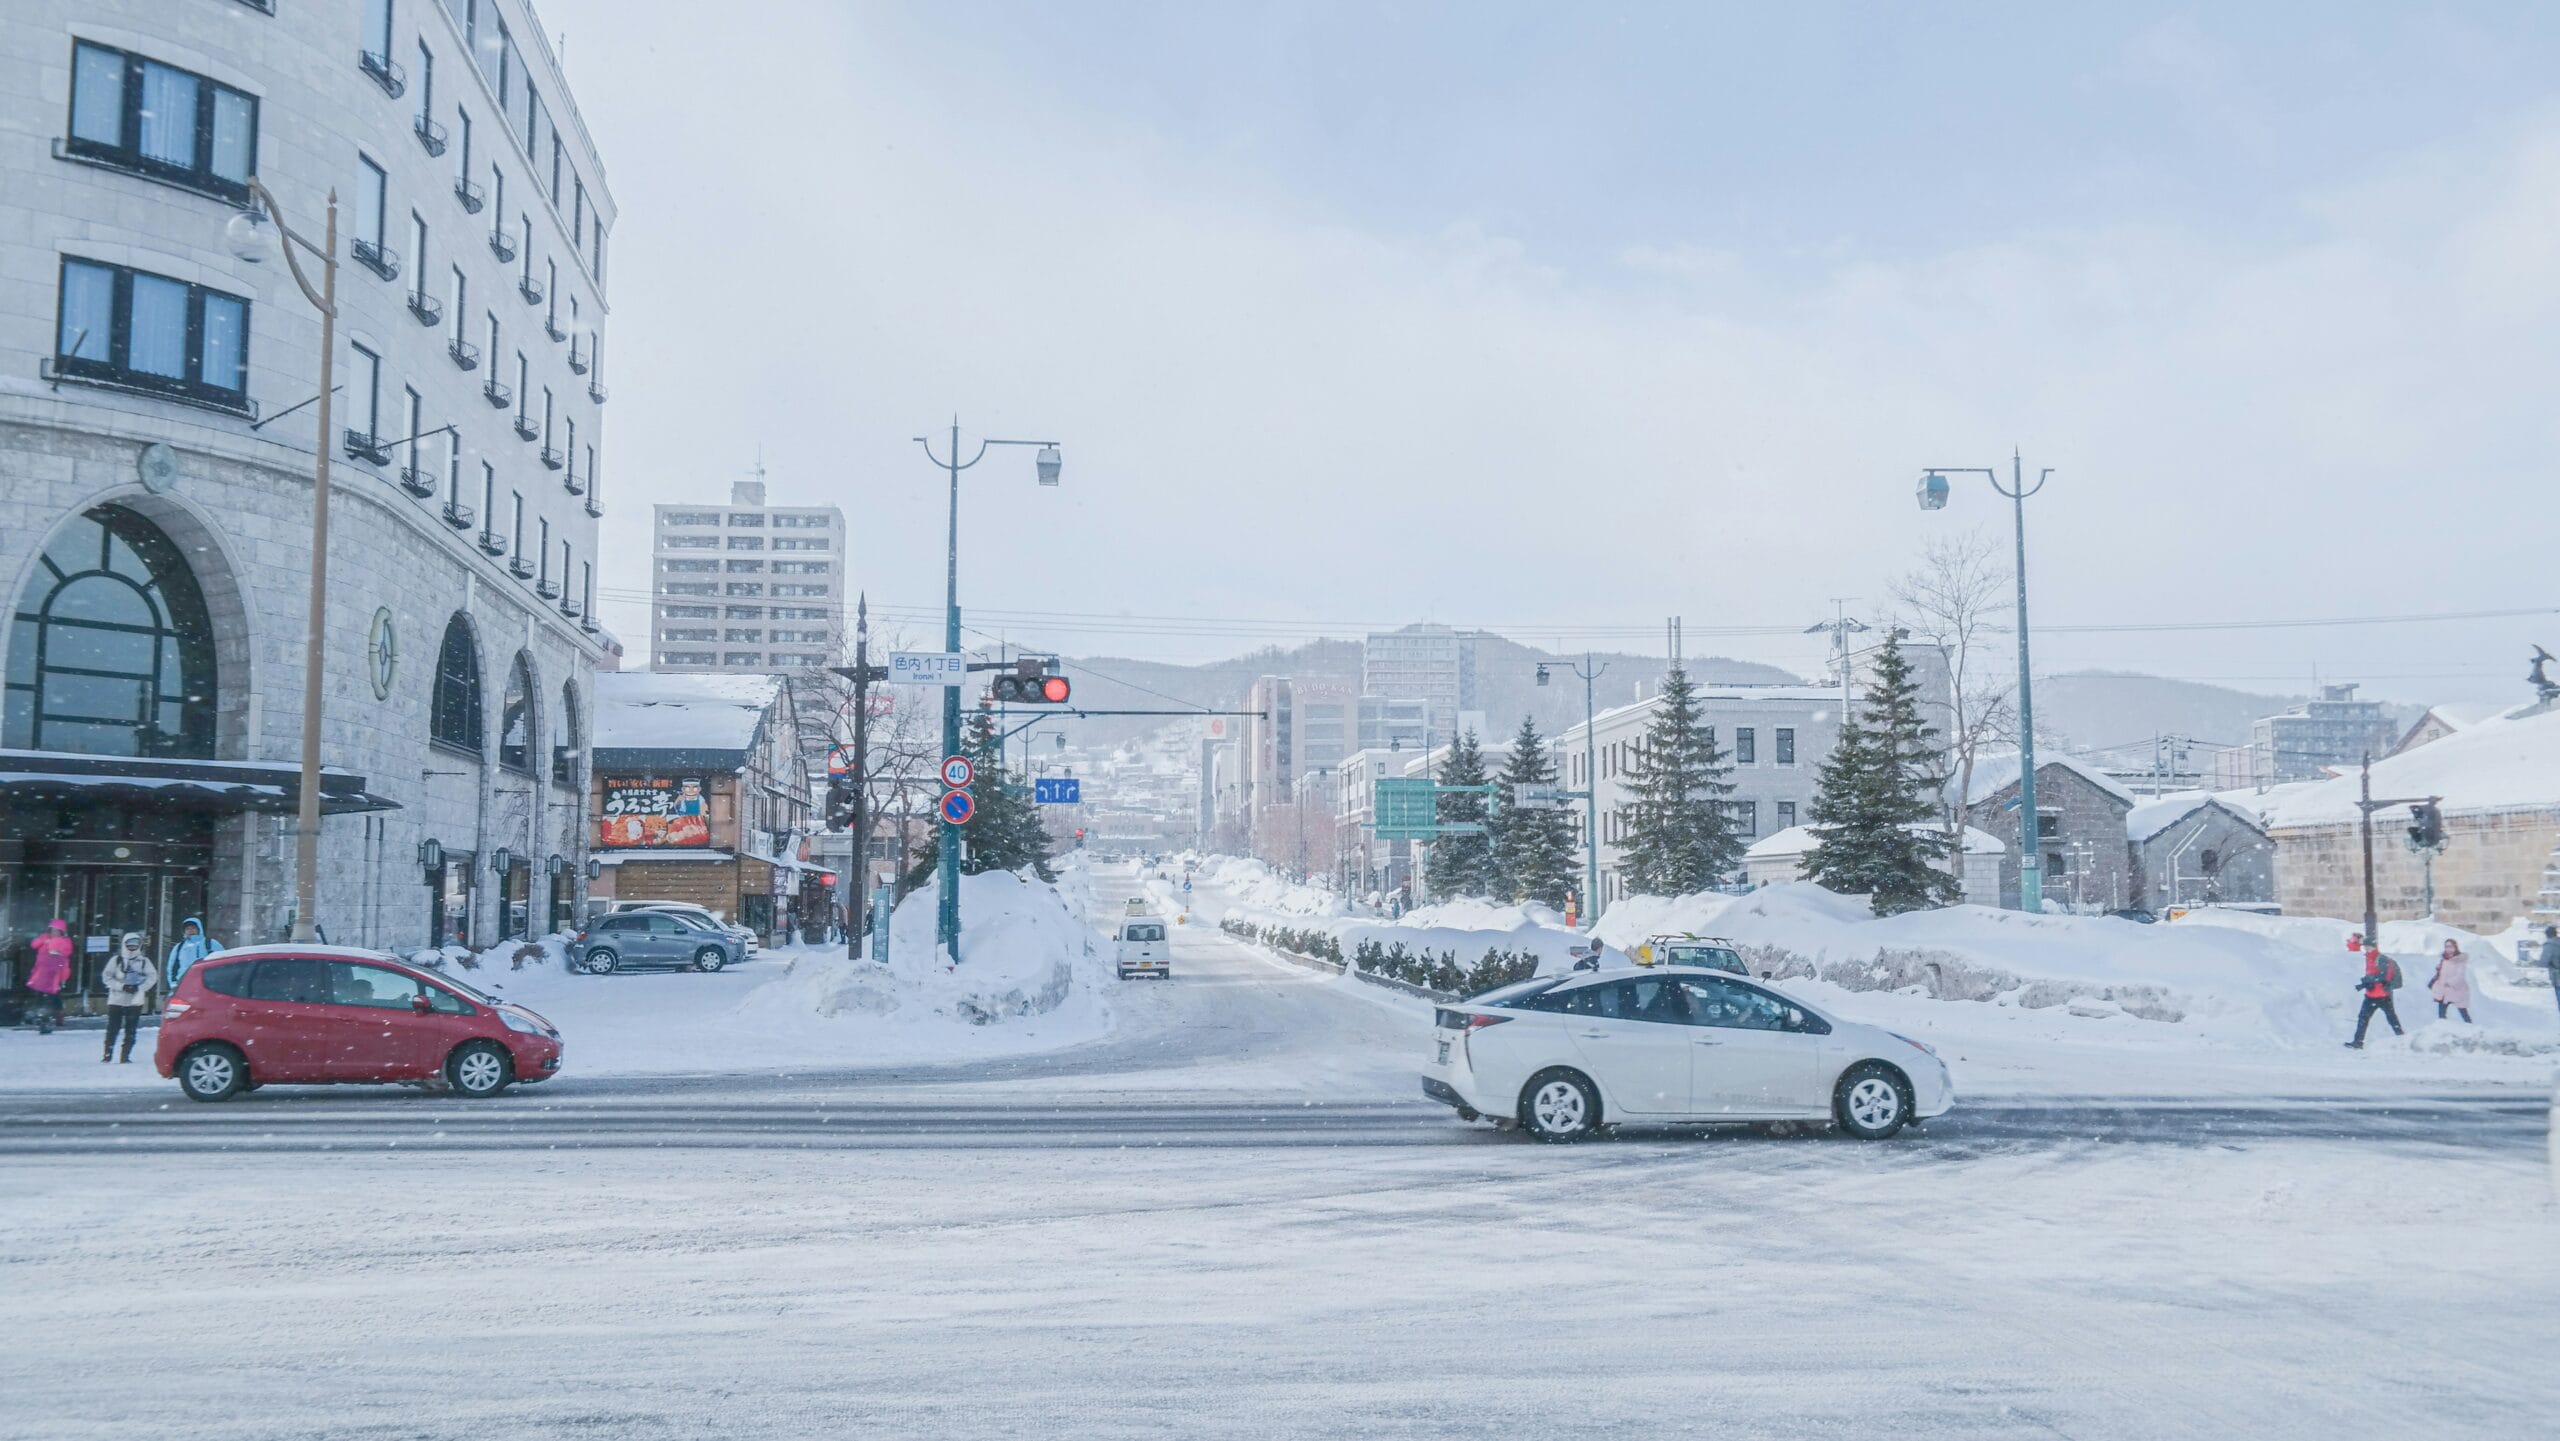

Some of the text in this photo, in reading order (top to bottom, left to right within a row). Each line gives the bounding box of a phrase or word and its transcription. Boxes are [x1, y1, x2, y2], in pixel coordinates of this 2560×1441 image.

[896, 657, 960, 671] 色内1丁目
[948, 765, 967, 780] 40
[606, 791, 674, 817] うろこ亭
